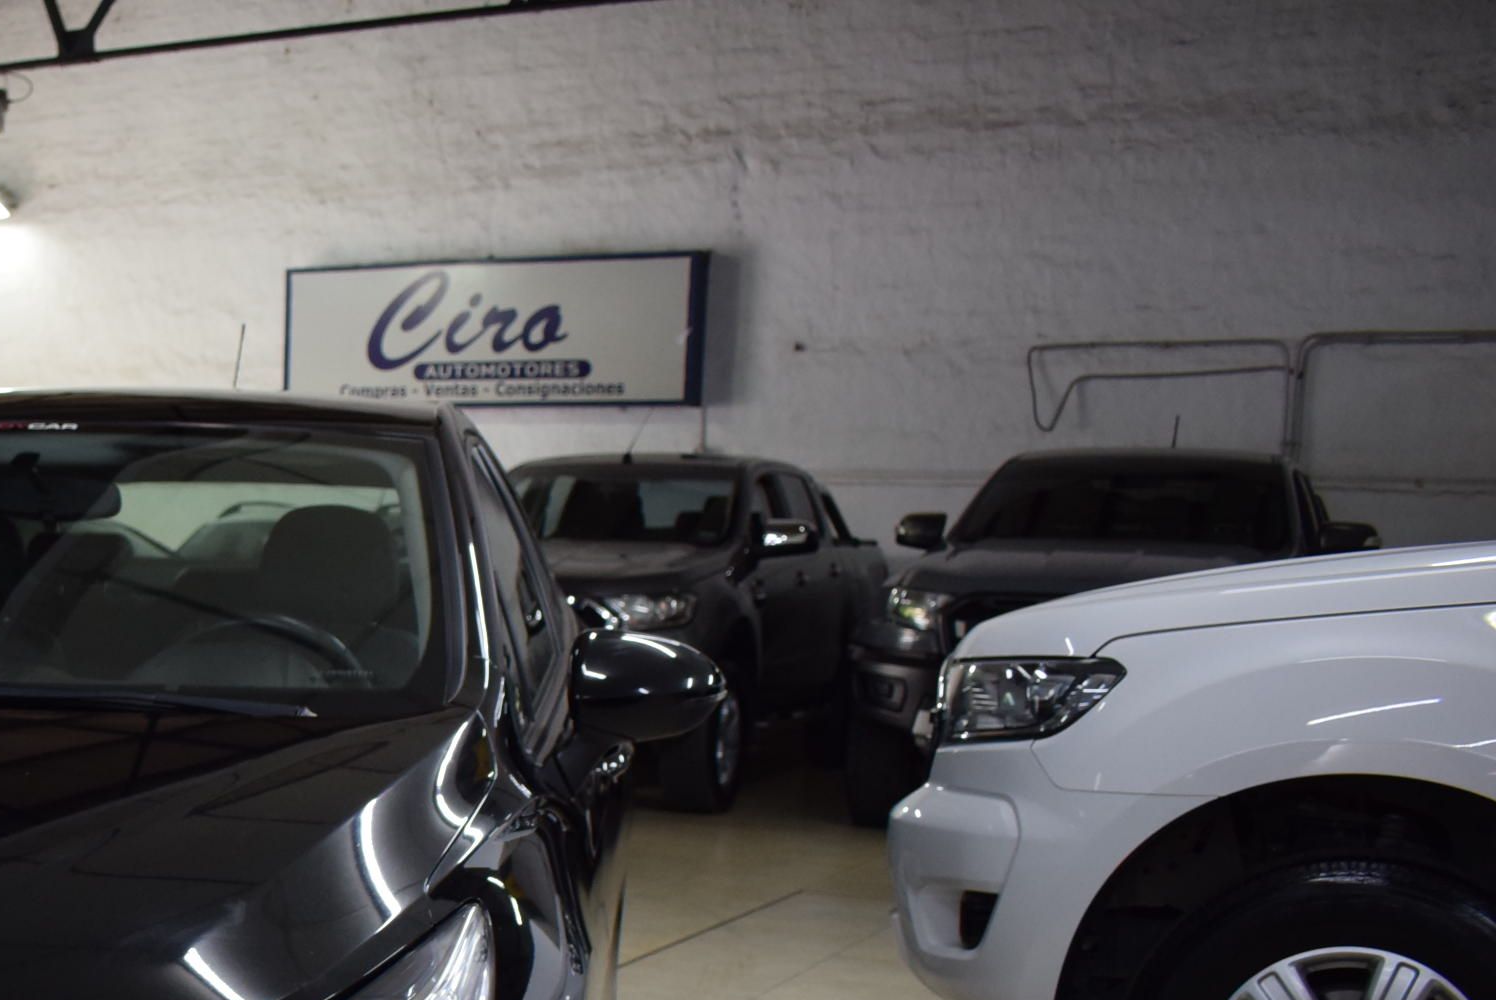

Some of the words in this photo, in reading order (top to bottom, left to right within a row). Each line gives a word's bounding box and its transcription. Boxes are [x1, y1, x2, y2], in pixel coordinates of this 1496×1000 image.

[367, 270, 568, 371] Ciro
[422, 360, 581, 379] AUTOMOTORES
[424, 383, 479, 398] Ventas
[494, 381, 625, 400] Consignaciones
